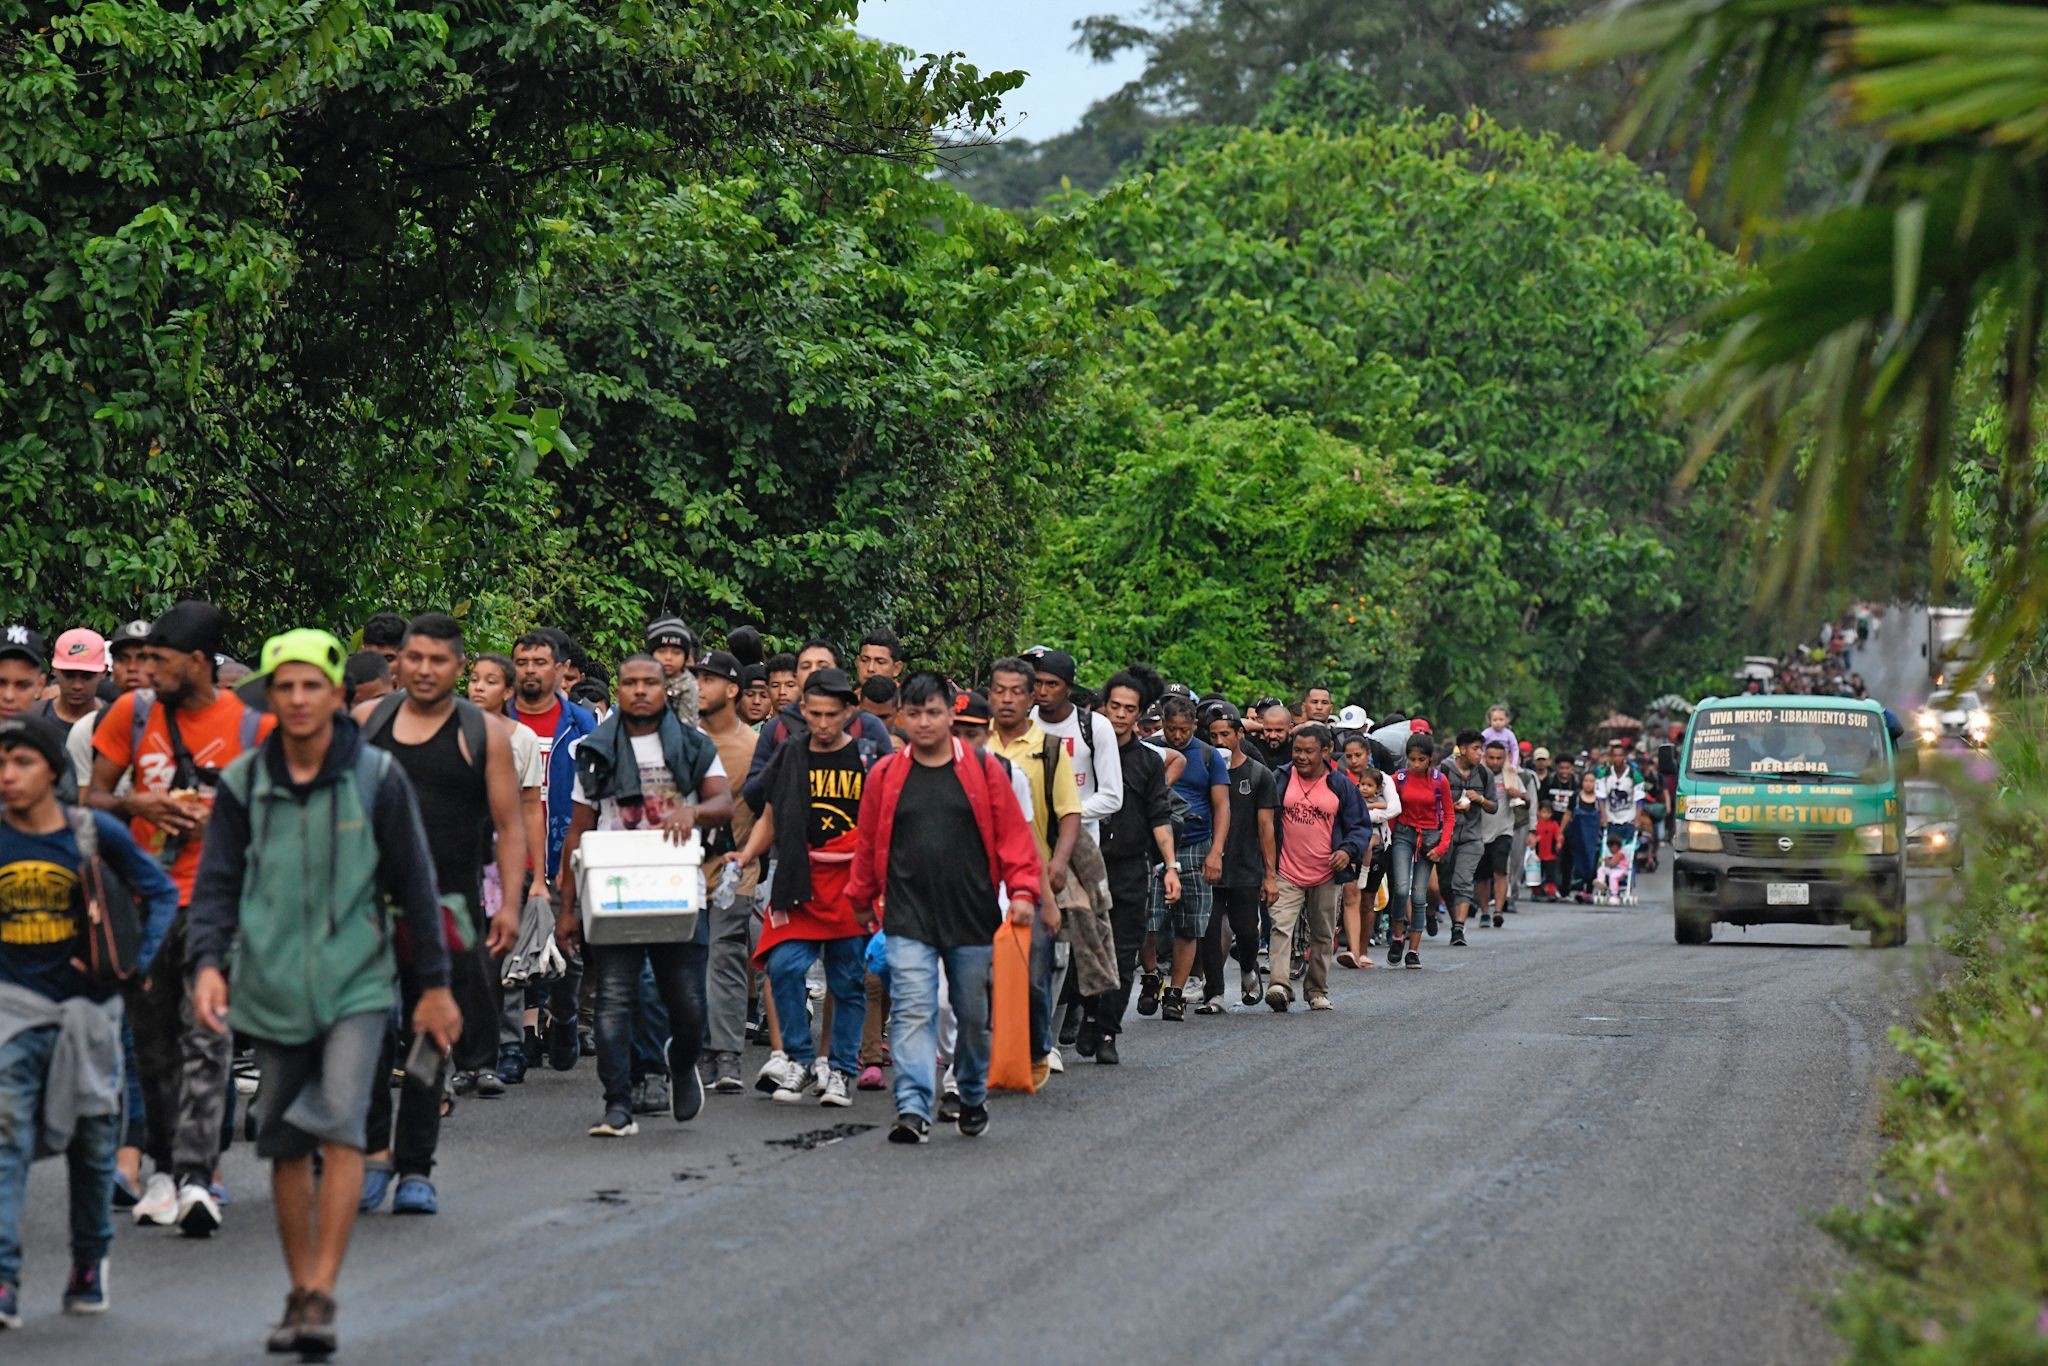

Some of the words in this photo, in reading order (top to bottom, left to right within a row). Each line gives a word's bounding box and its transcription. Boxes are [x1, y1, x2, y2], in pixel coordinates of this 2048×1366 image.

[1710, 711, 1733, 725] VIVA
[1735, 710, 1772, 724] MEXICO
[1780, 710, 1846, 725] LIBRAMIENTO
[1848, 713, 1868, 728] SUR
[1693, 747, 1730, 760] JUZGADOS
[1691, 757, 1731, 770] FEDERALES
[1750, 761, 1829, 773] DERECHA
[809, 769, 862, 800] RVANA
[1719, 804, 1854, 825] COLECTIVO
